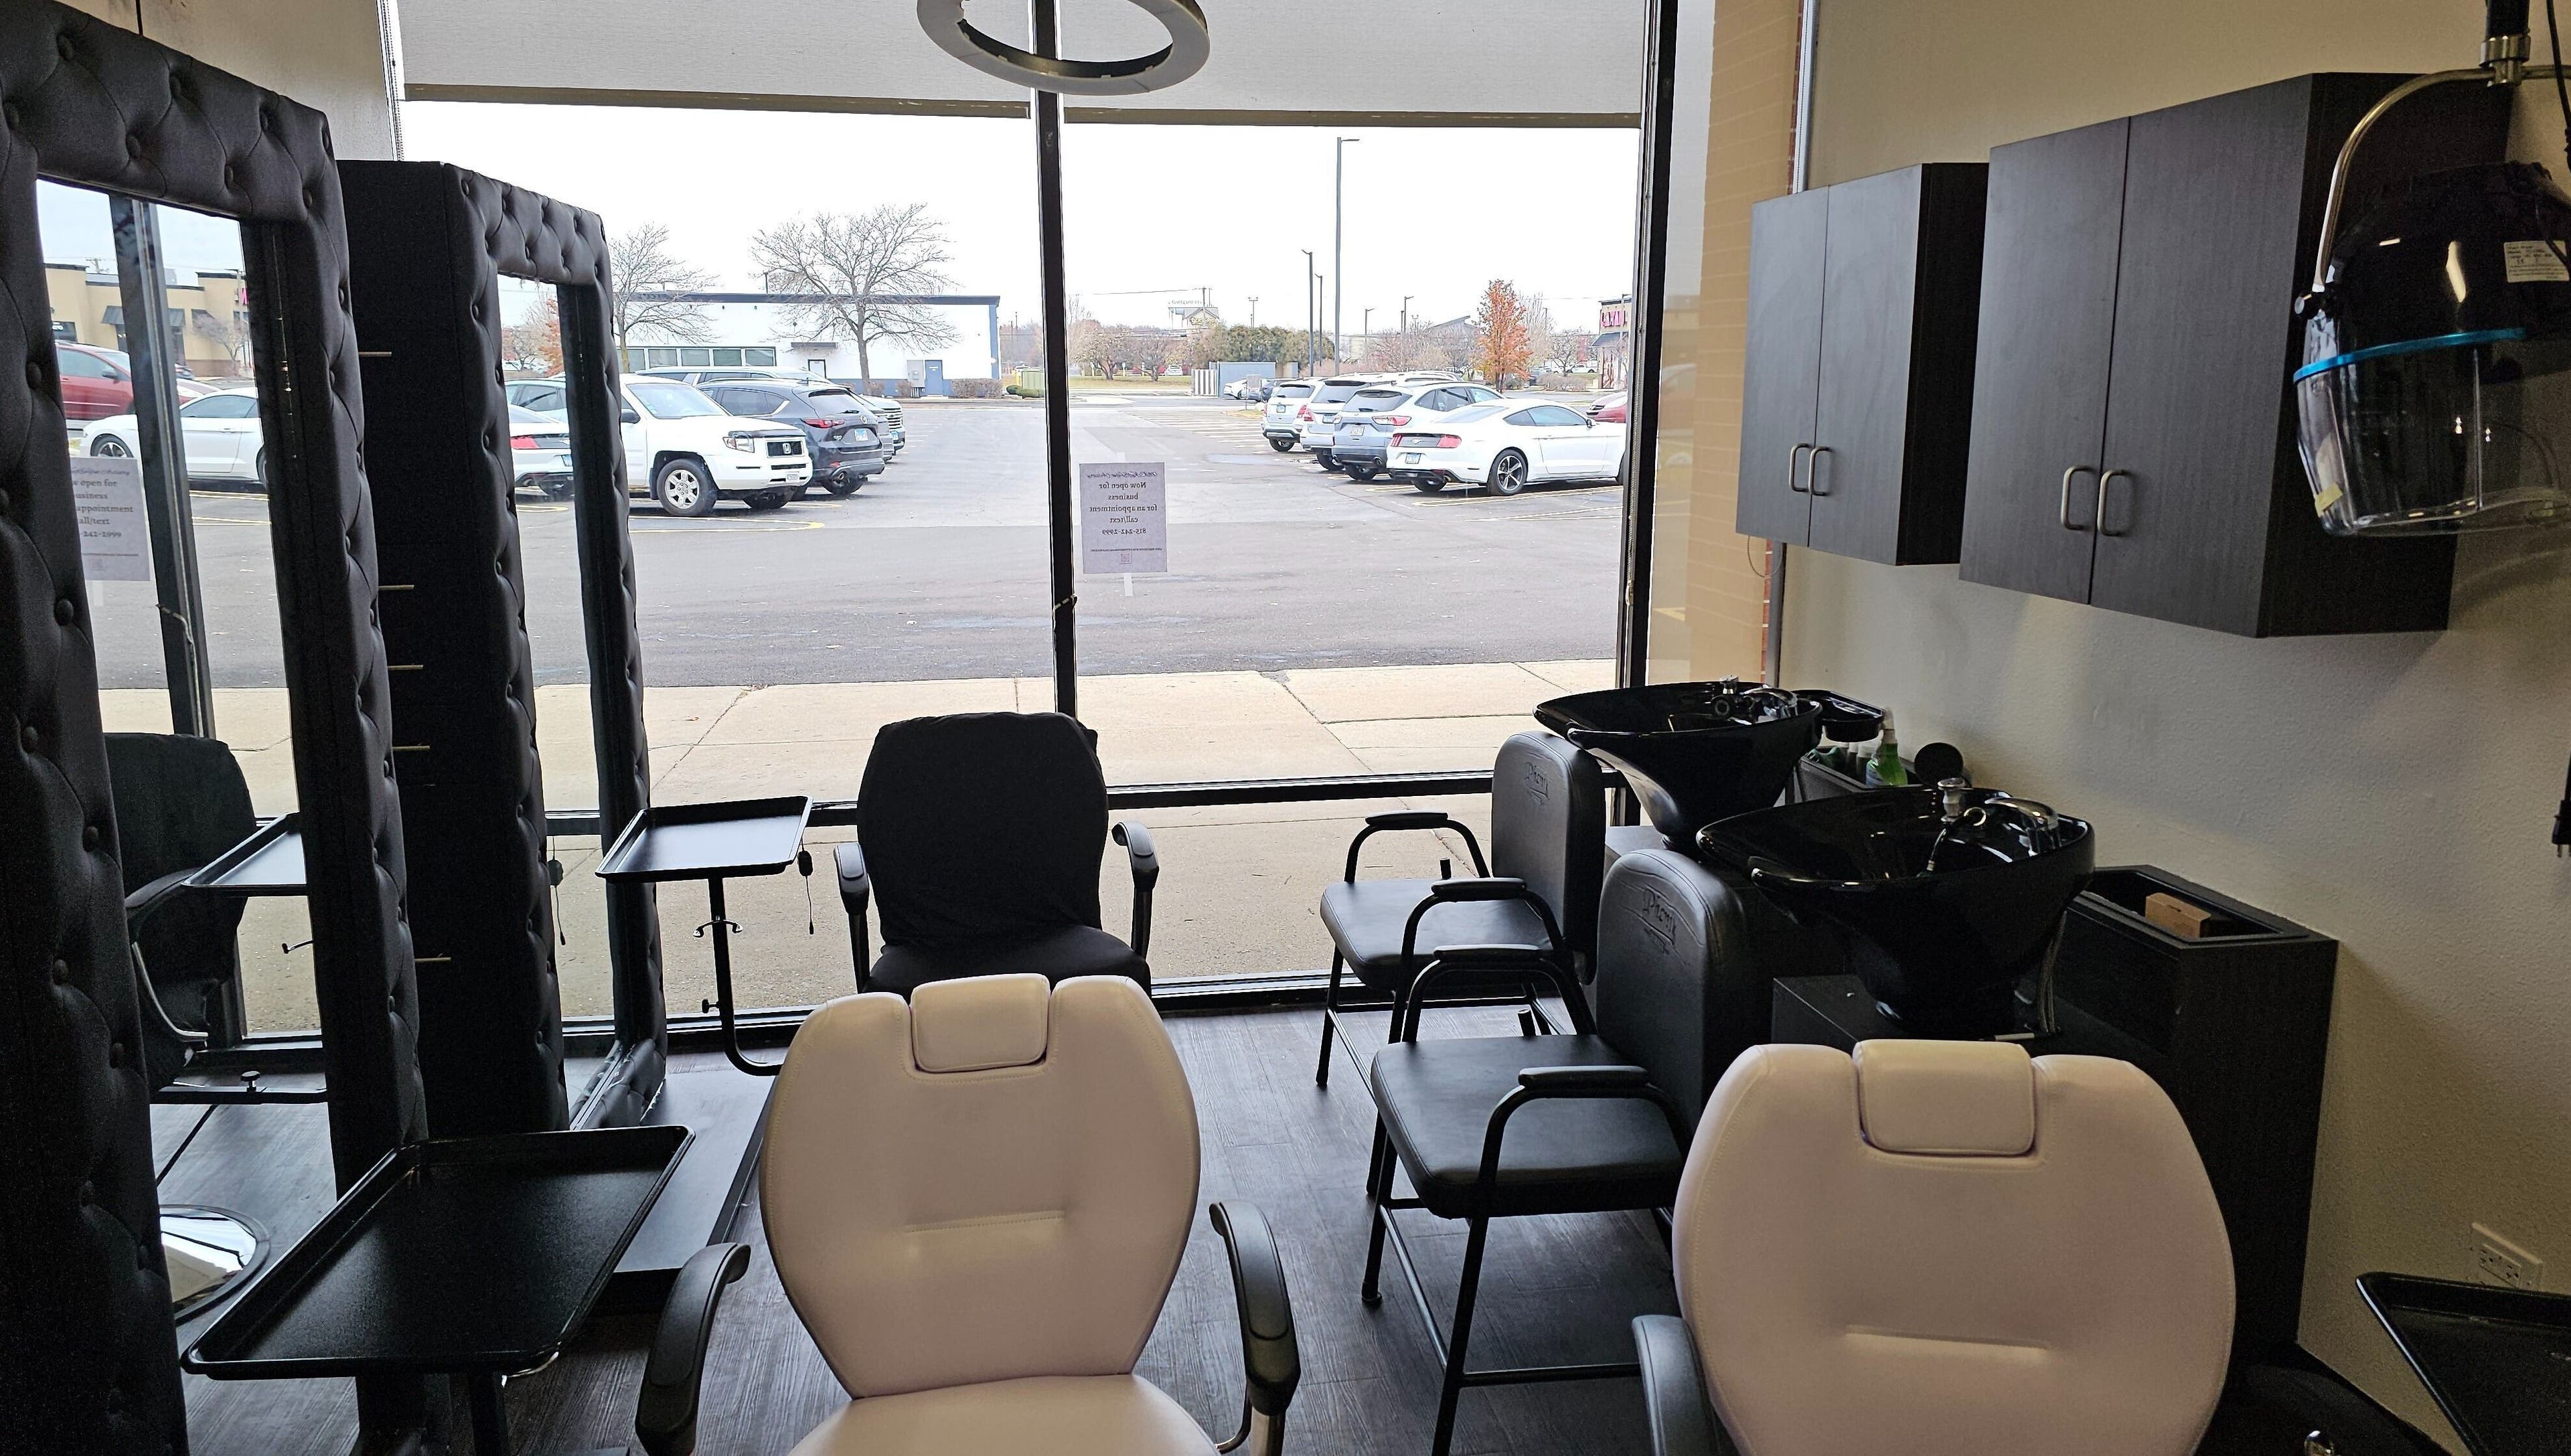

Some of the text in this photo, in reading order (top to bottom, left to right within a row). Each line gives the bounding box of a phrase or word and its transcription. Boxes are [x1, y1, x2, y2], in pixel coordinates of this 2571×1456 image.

[80, 481, 102, 489] open
[104, 479, 118, 487] for
[75, 491, 108, 499] usiness
[79, 516, 110, 525] all/text
